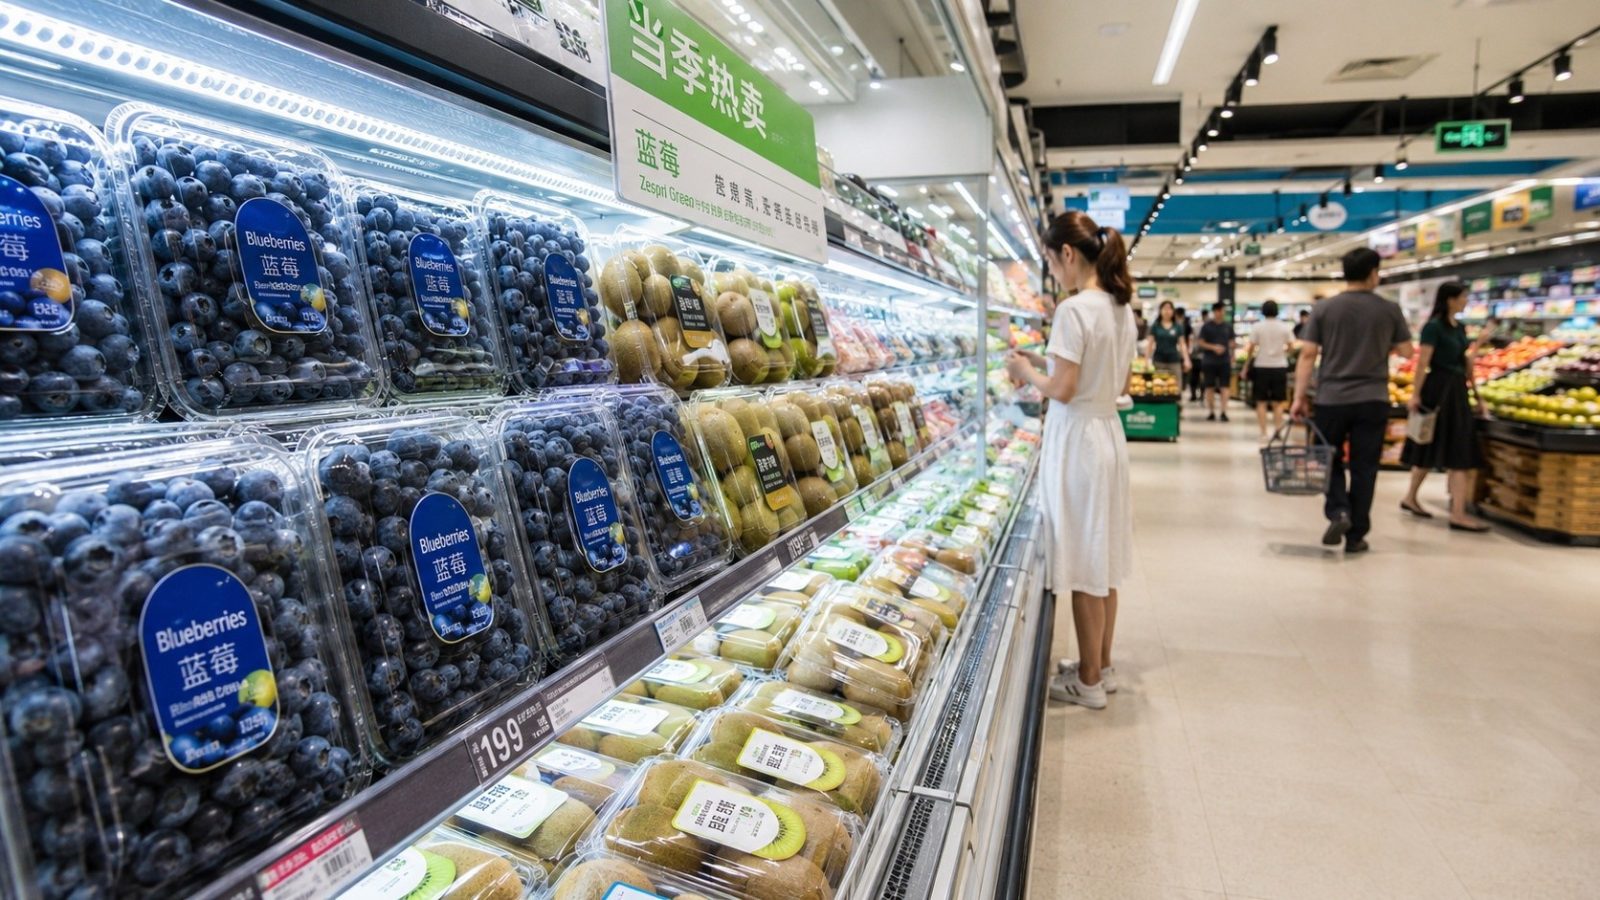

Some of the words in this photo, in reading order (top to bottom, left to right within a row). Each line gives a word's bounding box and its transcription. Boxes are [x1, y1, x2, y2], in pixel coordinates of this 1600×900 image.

[629, 0, 767, 139] 当季热卖
[635, 128, 680, 178] 蓝莓
[669, 185, 694, 209] Green
[245, 231, 306, 252] Blueberries
[260, 254, 300, 278] 蓝莓
[415, 256, 454, 273] Blueberries
[574, 486, 608, 504] Blueberries
[419, 528, 470, 554] Blueberries
[432, 552, 467, 583] 蓝莓
[155, 610, 248, 653] Blueberries
[177, 642, 239, 691] 蓝莓
[480, 718, 524, 769] 199
